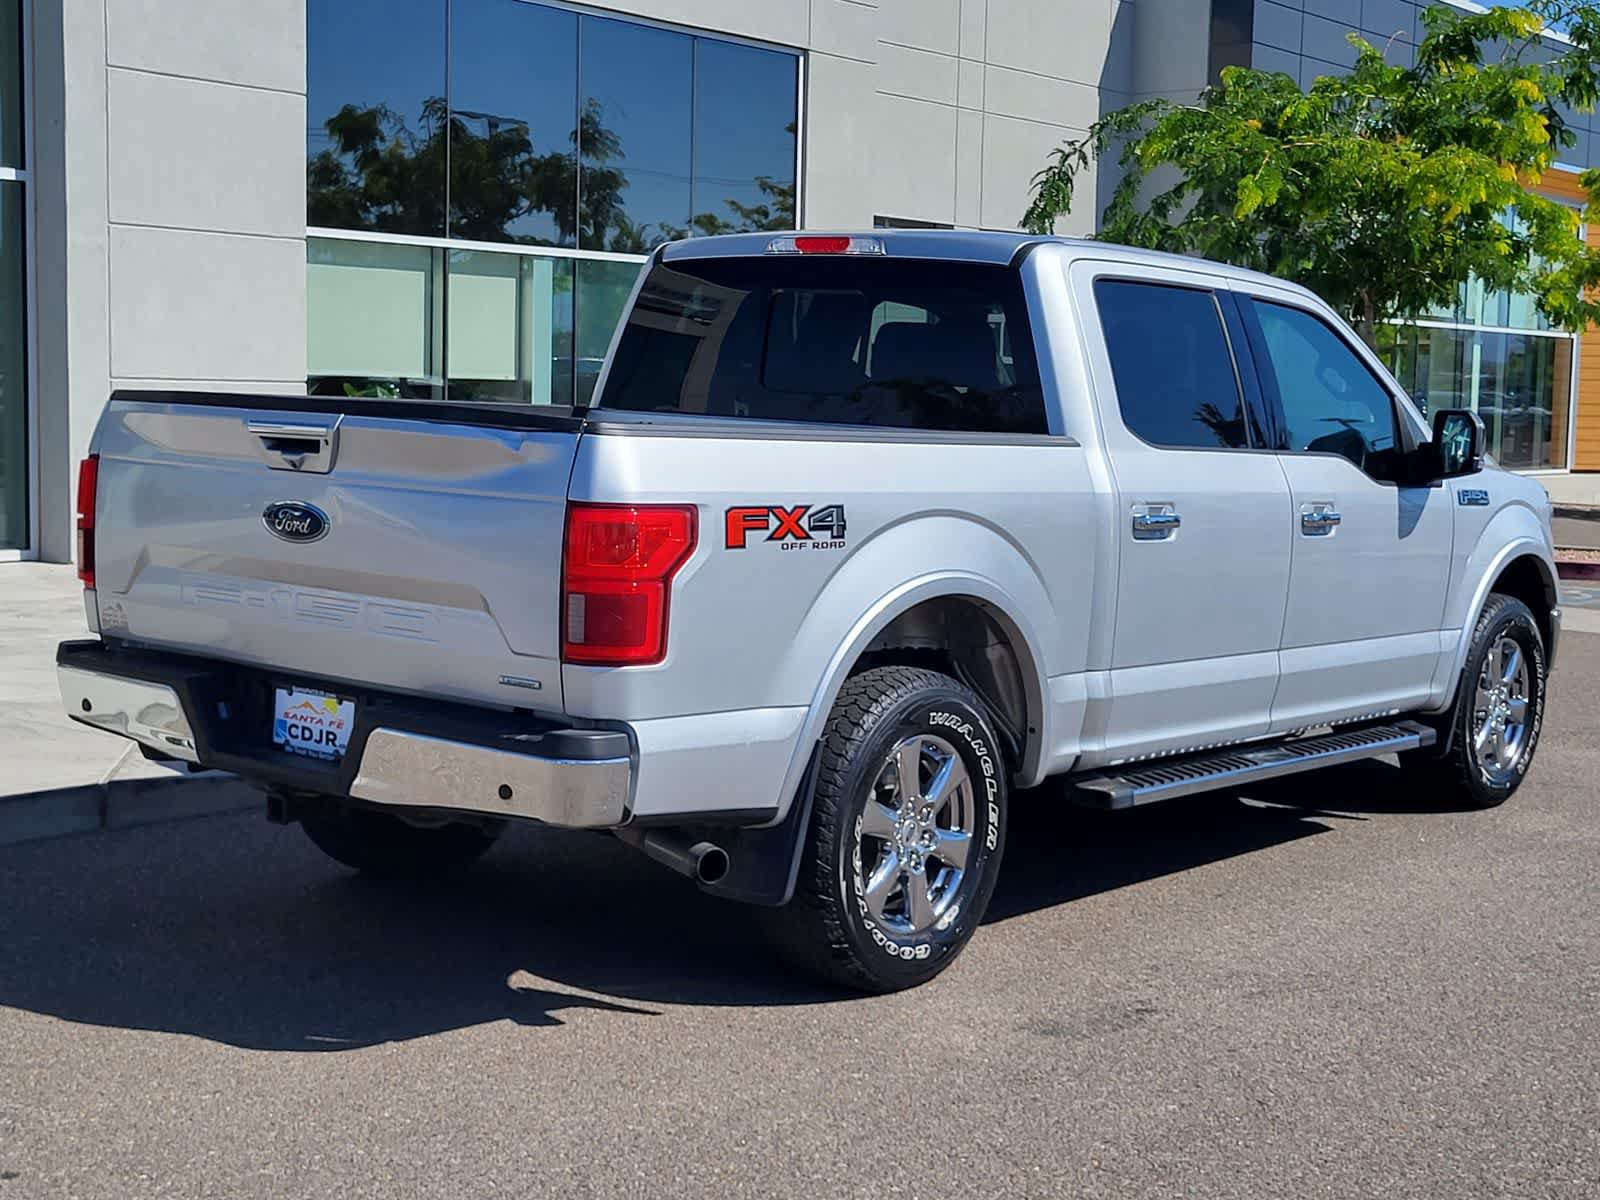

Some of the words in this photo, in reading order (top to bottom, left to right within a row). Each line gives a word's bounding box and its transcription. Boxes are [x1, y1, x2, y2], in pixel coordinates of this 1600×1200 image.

[275, 508, 311, 533] Ford
[725, 504, 846, 549] FX4
[781, 542, 807, 550] OFF
[812, 541, 846, 549] ROAD
[283, 711, 324, 727] SANTA
[288, 723, 337, 747] CDJR
[928, 711, 997, 850] WRANGLER
